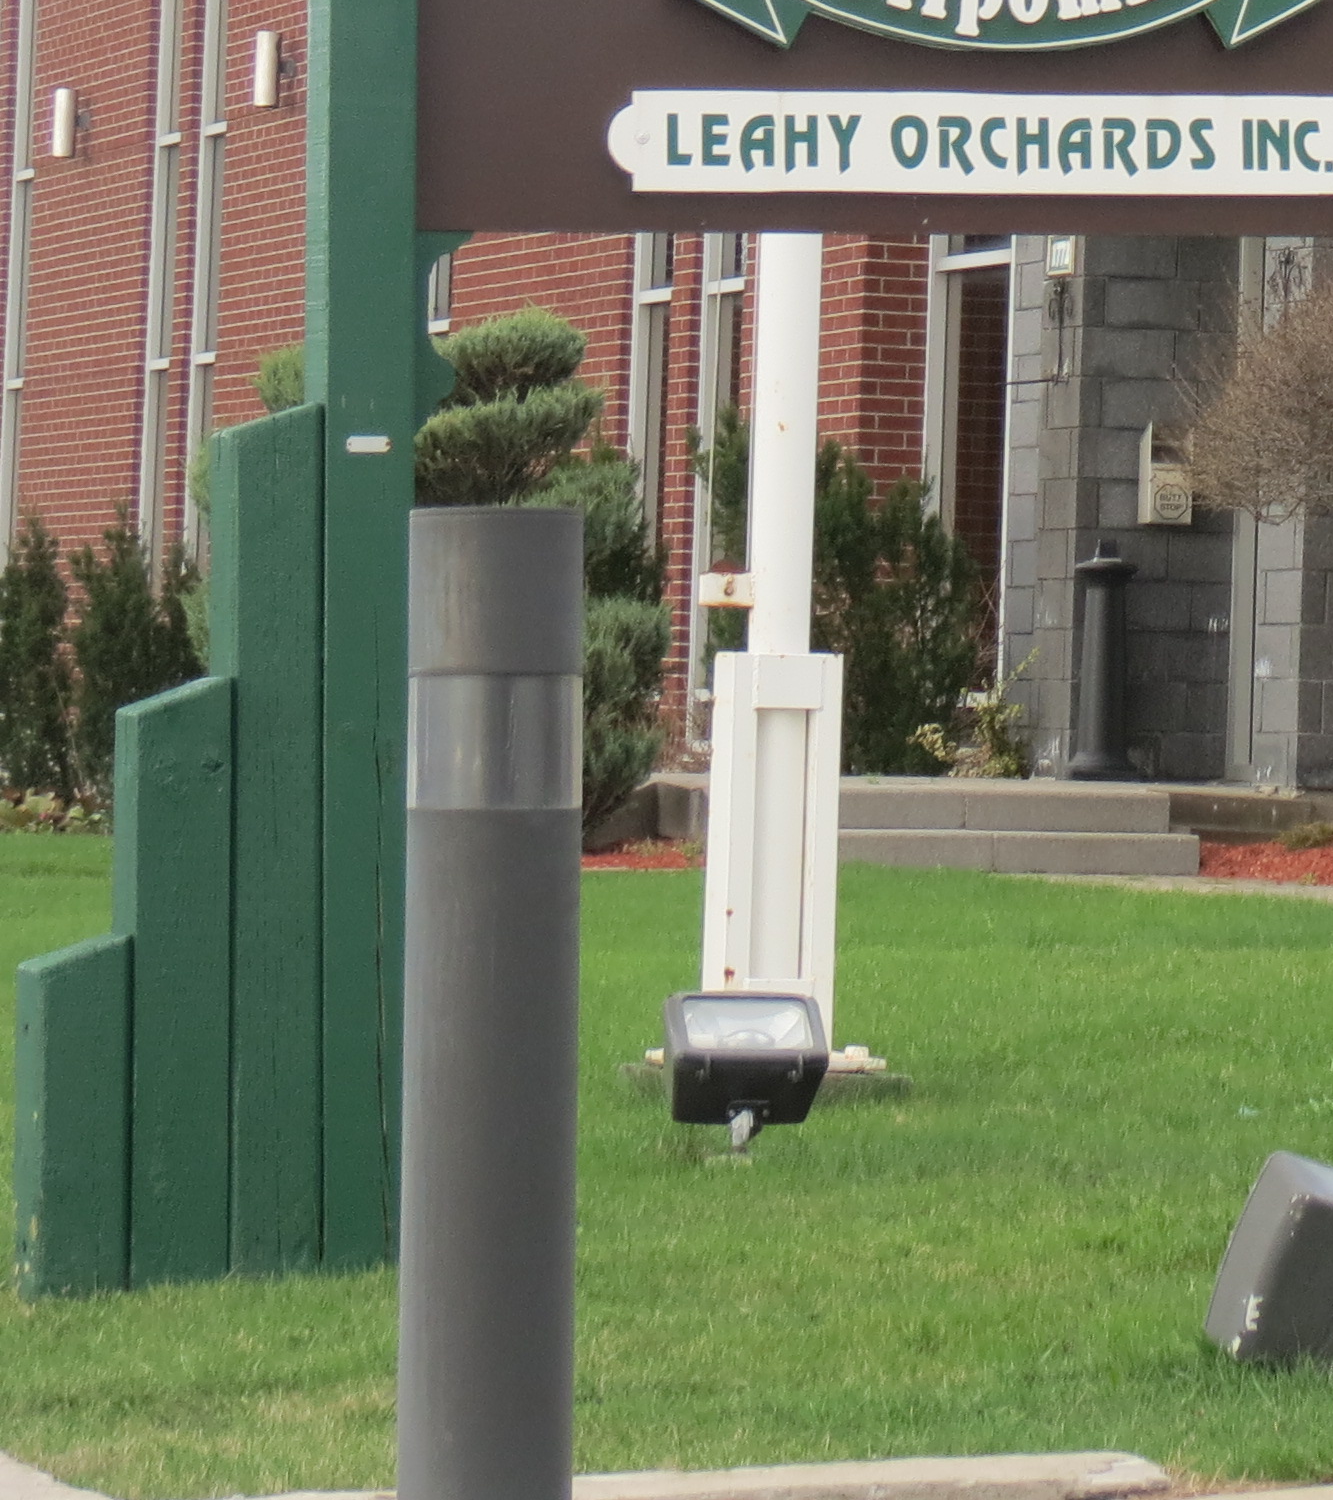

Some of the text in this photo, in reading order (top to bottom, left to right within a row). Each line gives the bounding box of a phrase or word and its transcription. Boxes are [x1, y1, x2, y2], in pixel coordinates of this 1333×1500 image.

[666, 113, 1333, 177] LEAHY ORCHARDS INC.
